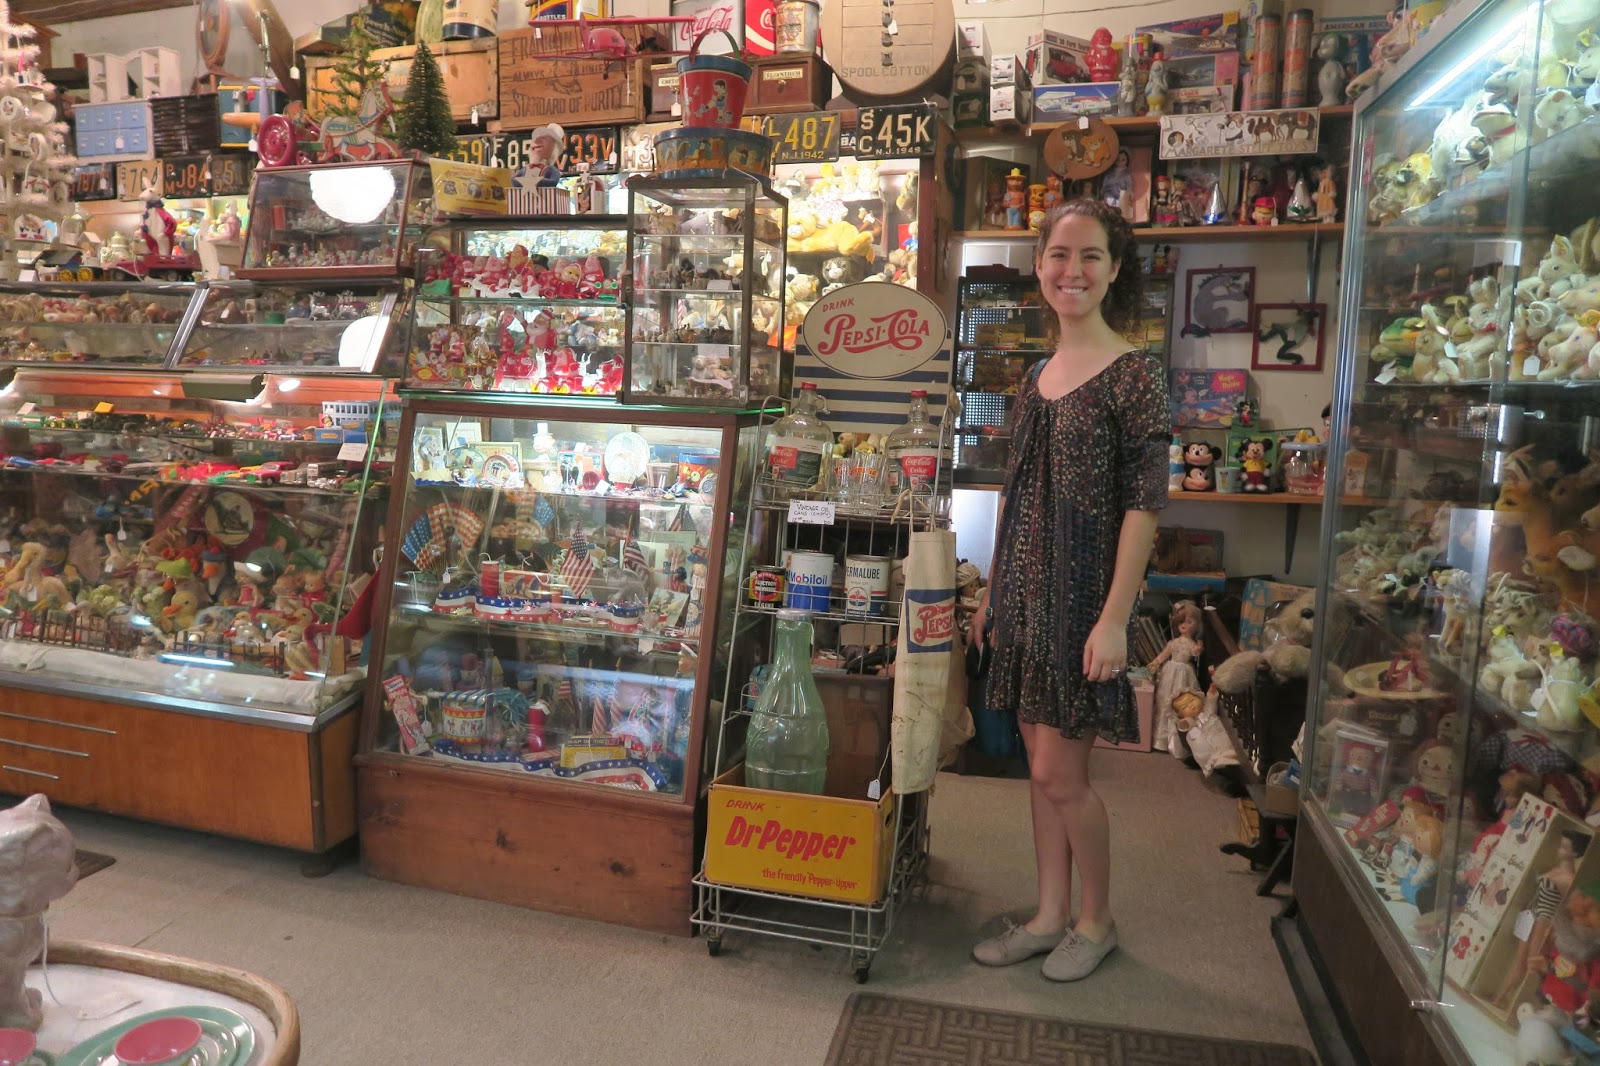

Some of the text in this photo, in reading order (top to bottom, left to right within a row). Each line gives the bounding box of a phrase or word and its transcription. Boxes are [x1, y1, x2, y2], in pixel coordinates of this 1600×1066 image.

[1324, 21, 1365, 30] AMERICAN
[841, 65, 931, 78] SPOOL COTTON
[512, 81, 623, 117] STANDARD OF PURITY
[784, 116, 836, 150] 487
[877, 113, 931, 149] 45K
[896, 146, 921, 155] 1949
[176, 163, 208, 189] J84
[822, 298, 855, 313] DRINK
[789, 571, 828, 585] Mobiloil
[725, 800, 765, 812] DRINK
[762, 867, 858, 890] the friendly Pepper-Upper
